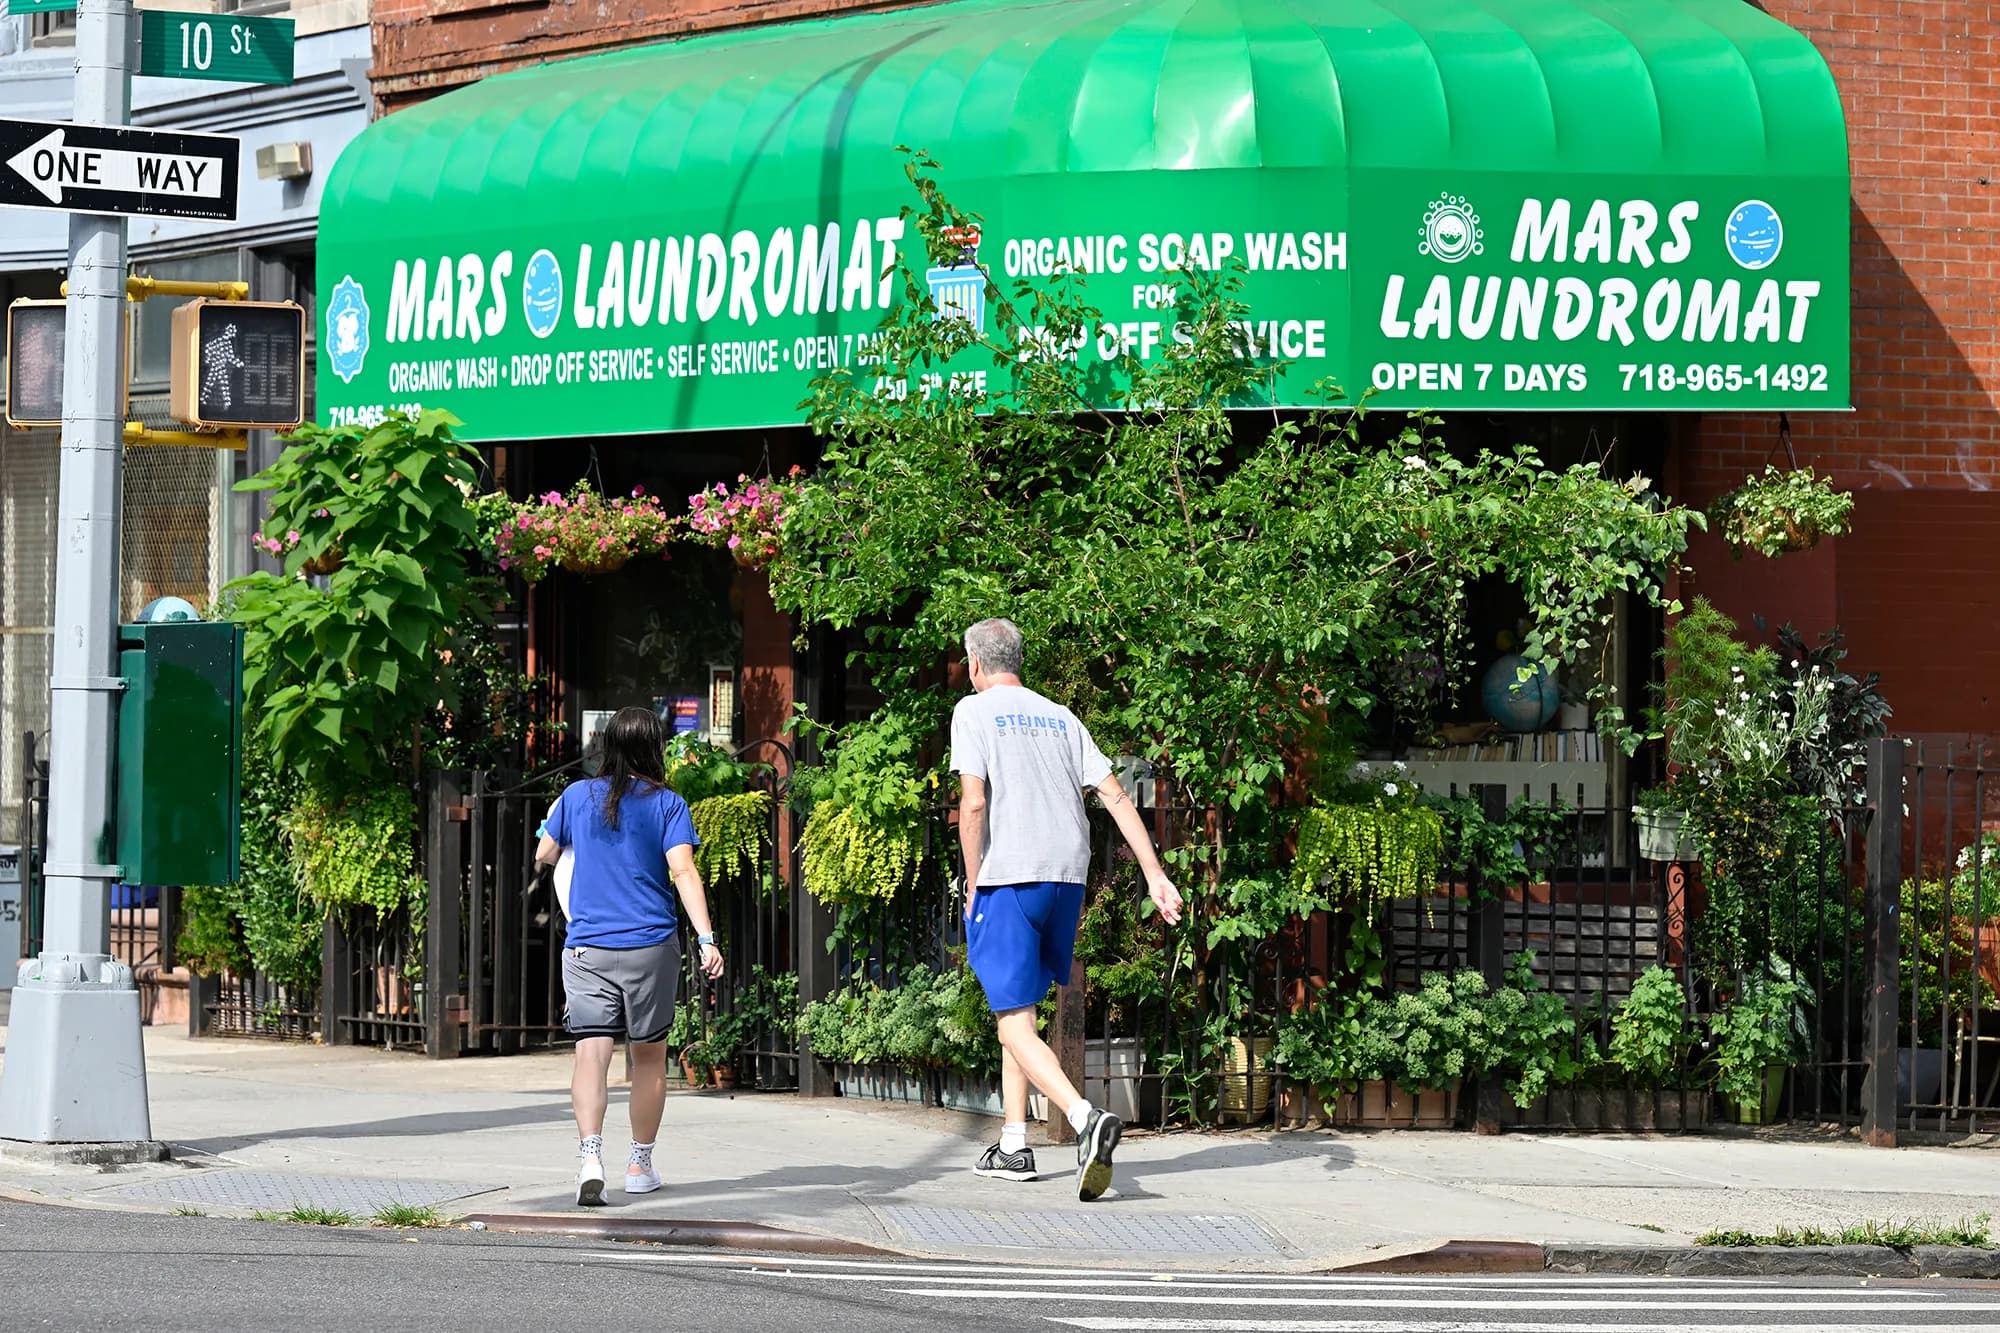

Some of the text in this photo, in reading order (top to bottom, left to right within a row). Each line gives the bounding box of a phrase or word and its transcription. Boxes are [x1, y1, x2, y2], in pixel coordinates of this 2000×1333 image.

[181, 22, 252, 70] 10 St
[33, 149, 208, 192] ONE WAY
[1004, 232, 1347, 277] ORGANIC SOAP WASH
[1510, 198, 1699, 269] MARS
[386, 217, 905, 344] MARS LAUNDROMAT
[1379, 274, 1821, 347] LAUNDROMAT
[1097, 322, 1161, 361] OFF
[1171, 319, 1326, 360] SRVICE
[389, 359, 452, 393] ORGANIC
[456, 356, 498, 389] WASH
[511, 354, 551, 387] DROP
[555, 351, 585, 384] OFF
[588, 347, 654, 382] SERVICE
[667, 344, 707, 378] SELF
[711, 339, 779, 375] SERVICE
[793, 335, 838, 373] OPEN
[843, 335, 853, 367] 7
[1371, 363, 1828, 392] OPEN 7 DAYS 718-965-1492
[995, 713, 1067, 731] STEINER
